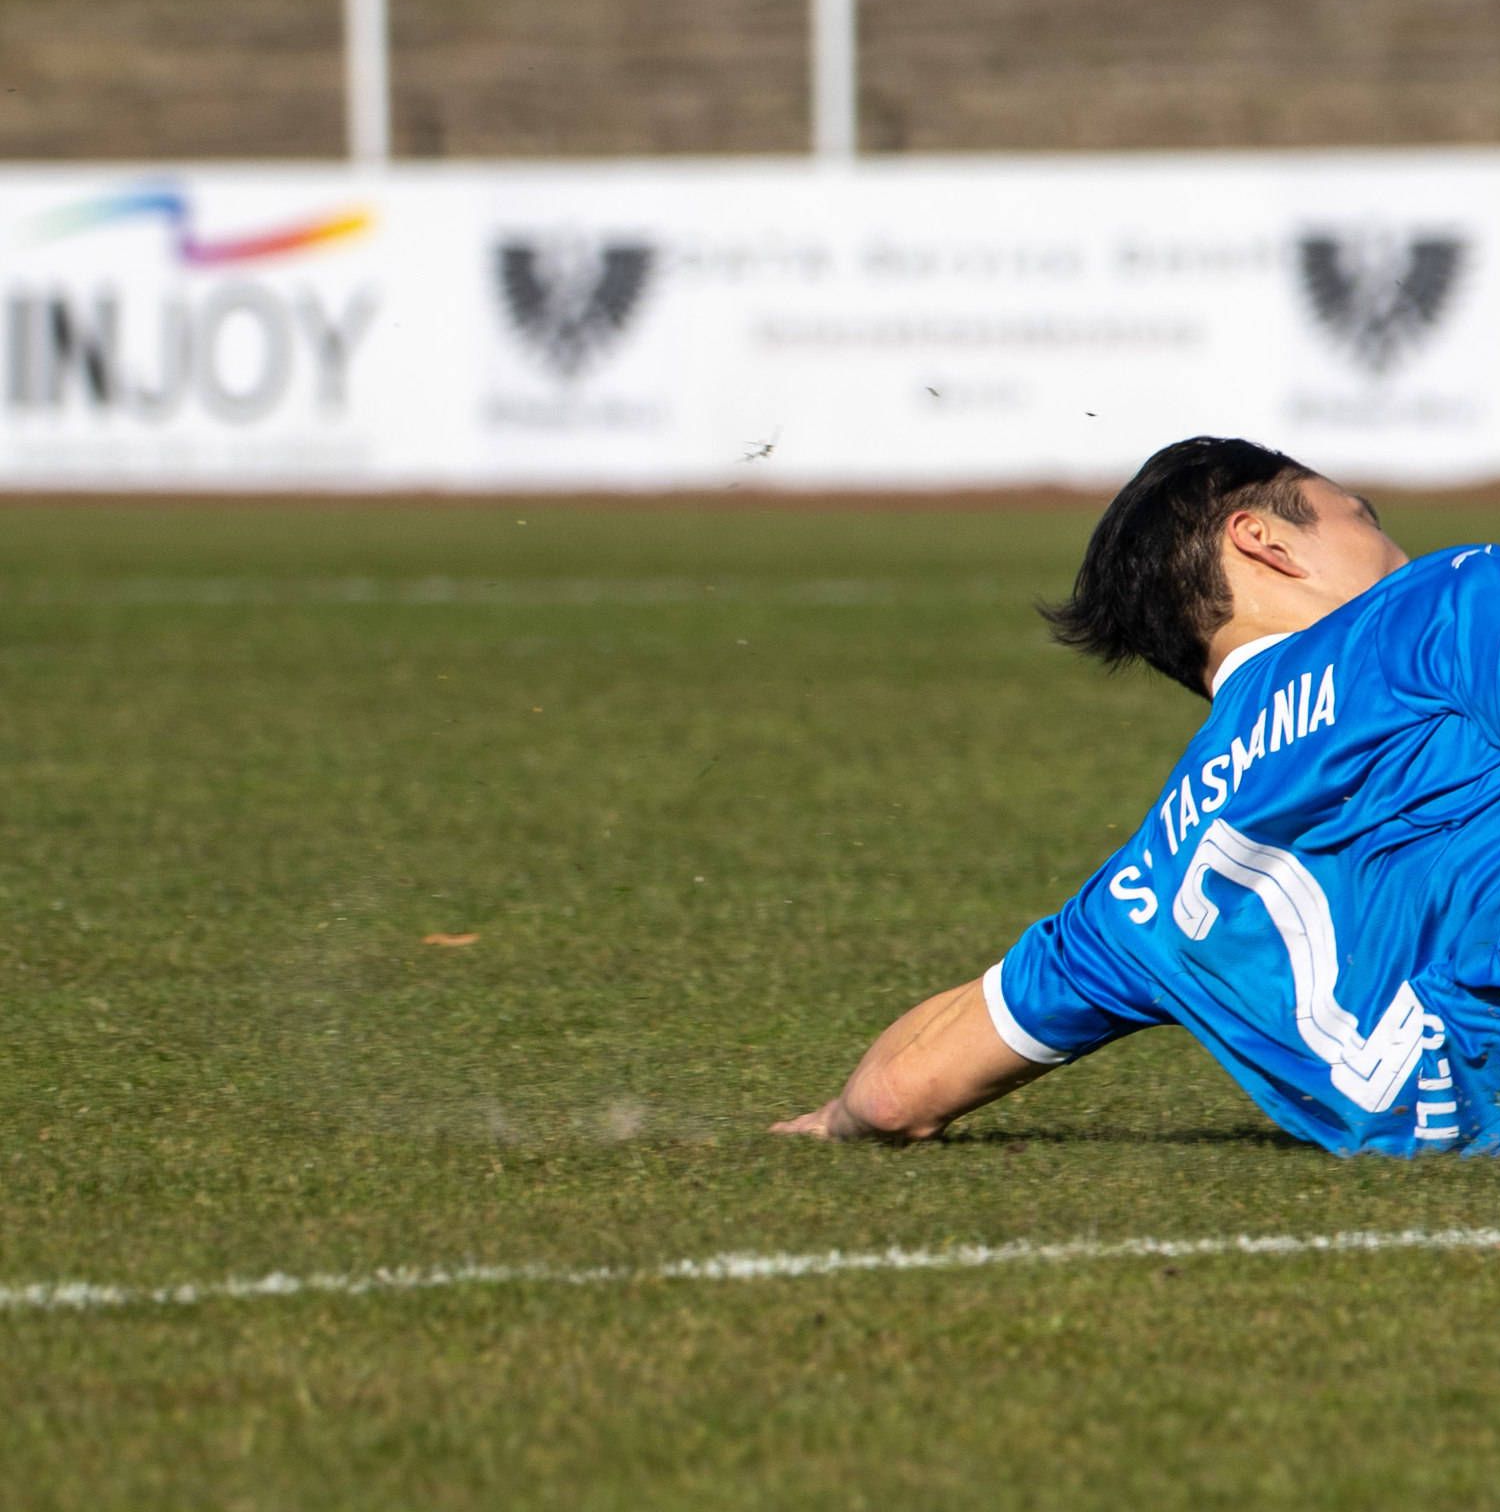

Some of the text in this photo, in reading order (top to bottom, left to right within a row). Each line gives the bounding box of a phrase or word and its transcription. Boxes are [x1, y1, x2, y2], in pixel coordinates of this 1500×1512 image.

[5, 283, 376, 420] INJOY
[1160, 664, 1336, 856] TASMANIA
[1173, 819, 1424, 1113] 2
